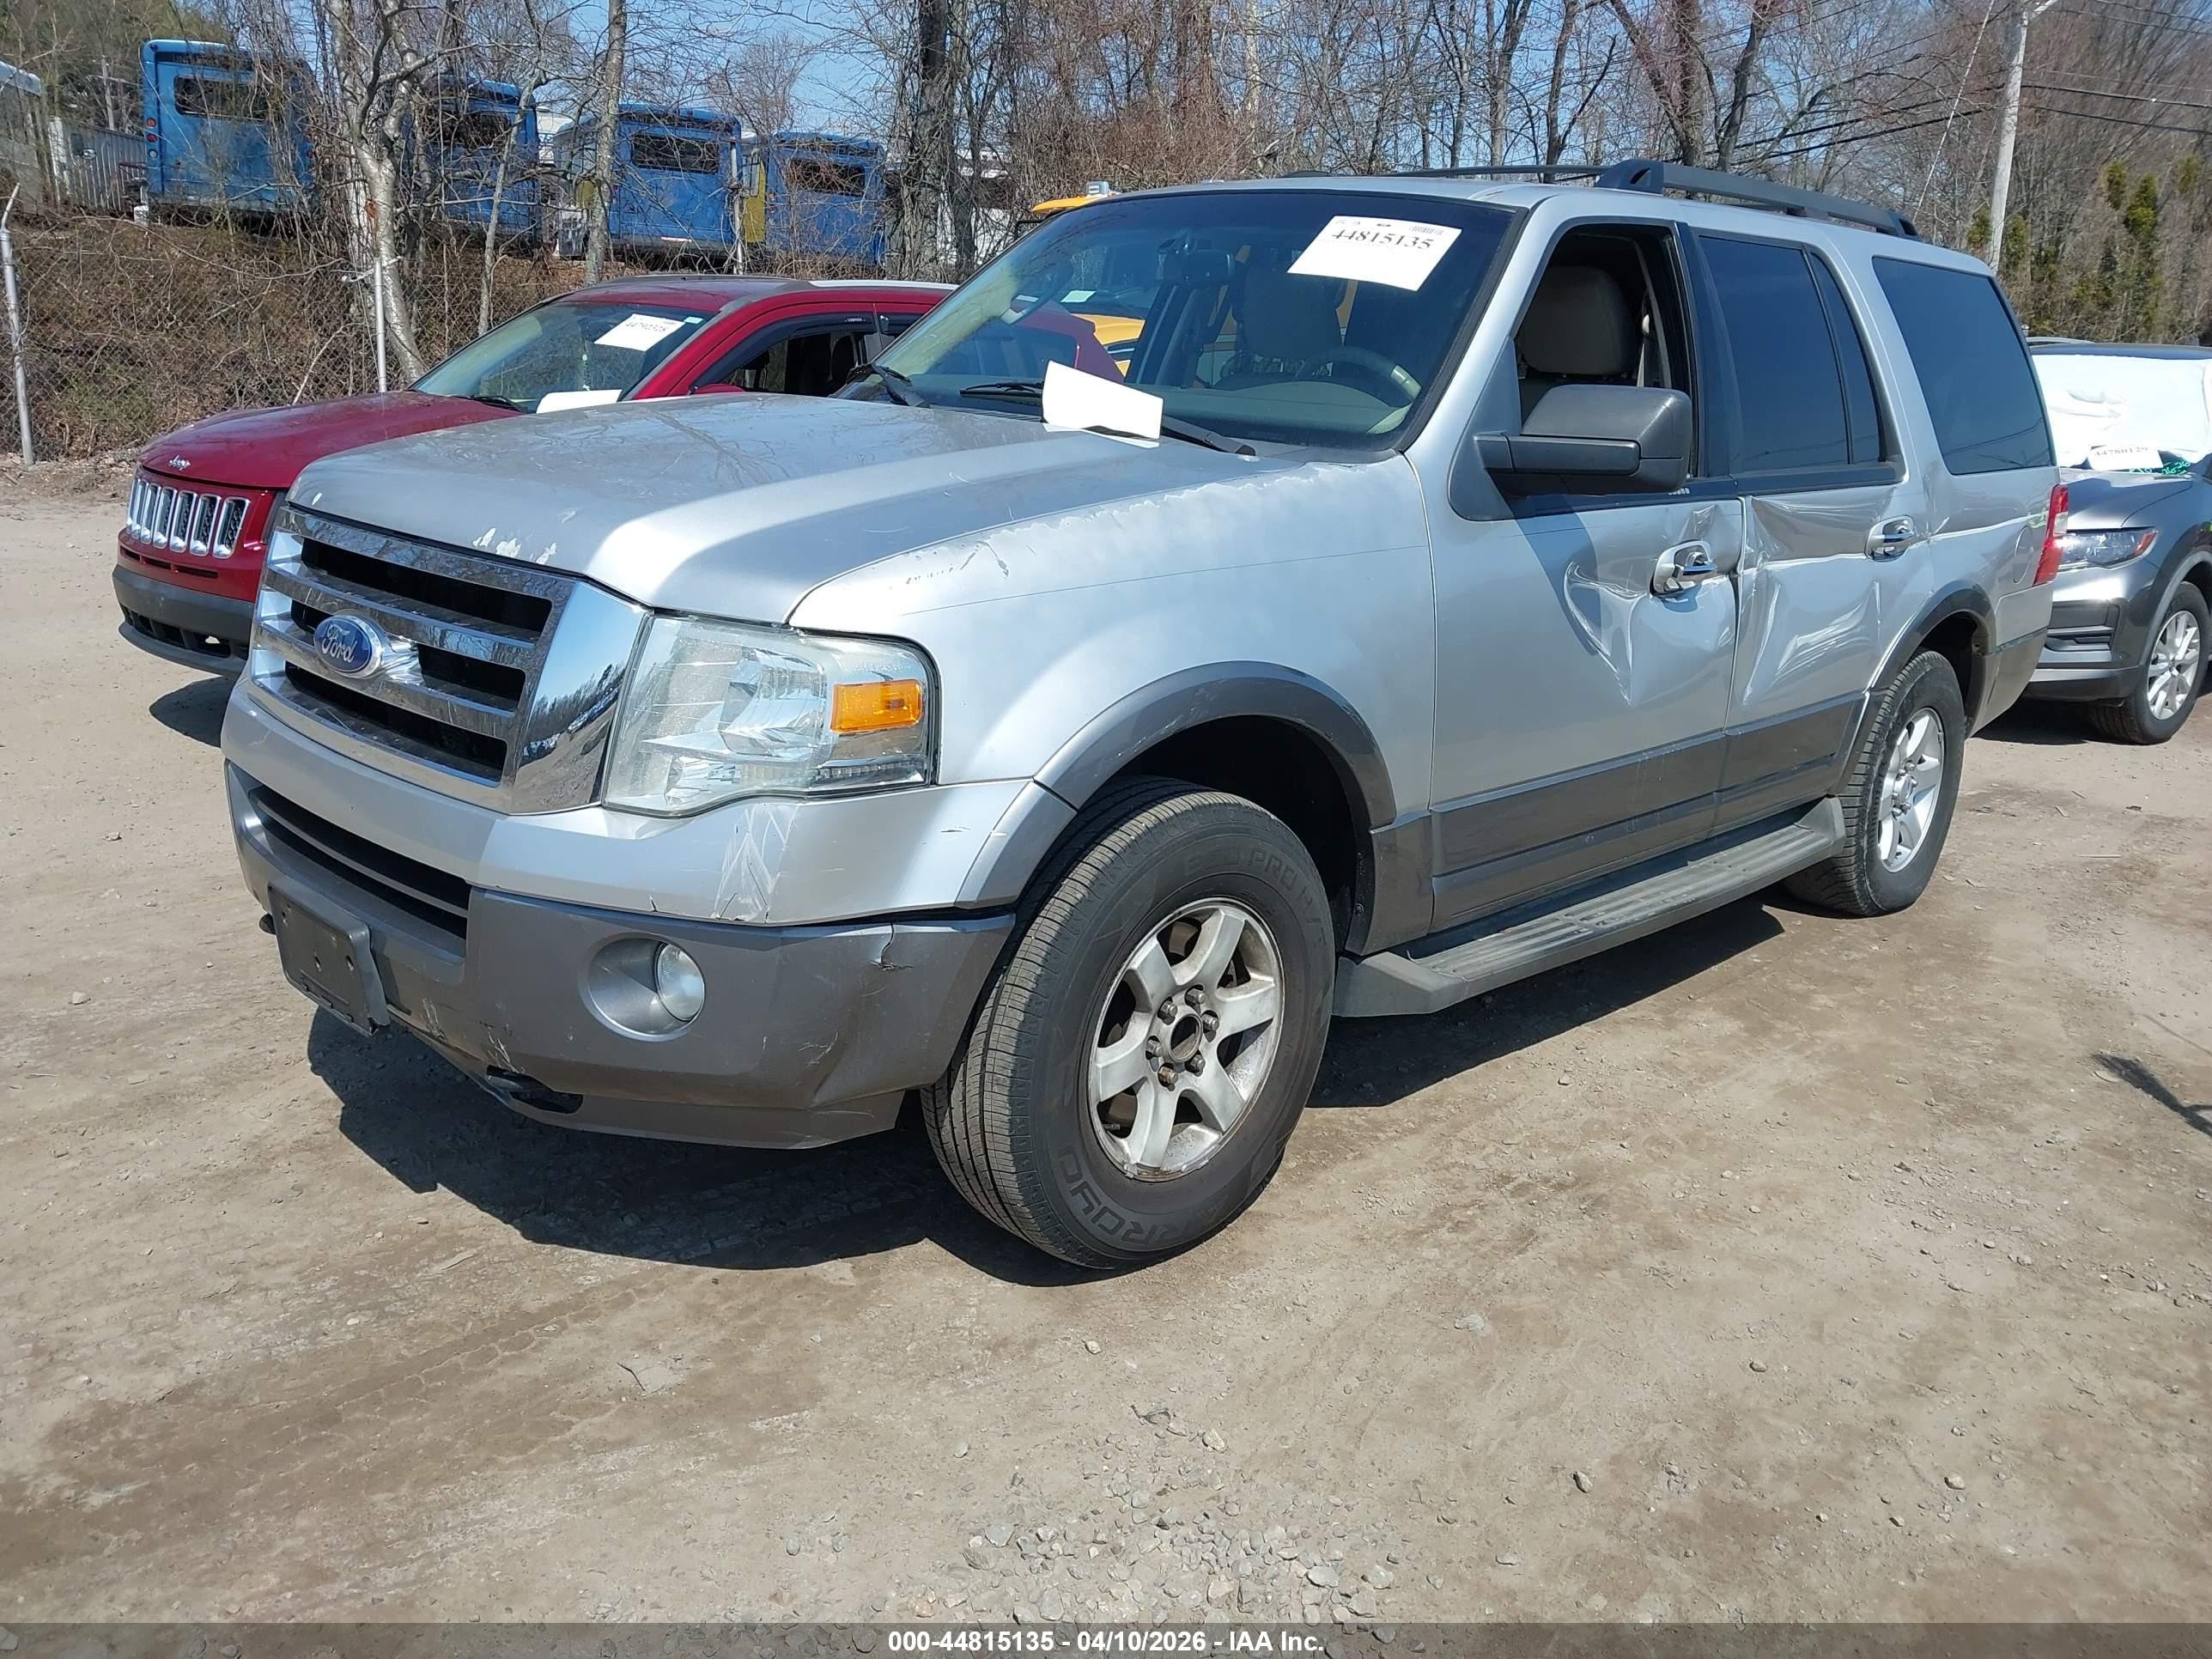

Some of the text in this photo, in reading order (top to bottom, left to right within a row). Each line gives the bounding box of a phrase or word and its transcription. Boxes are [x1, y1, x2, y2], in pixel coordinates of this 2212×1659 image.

[1332, 229, 1434, 249] 44815135
[321, 623, 357, 663] Ford
[1248, 848, 1298, 890] PRO
